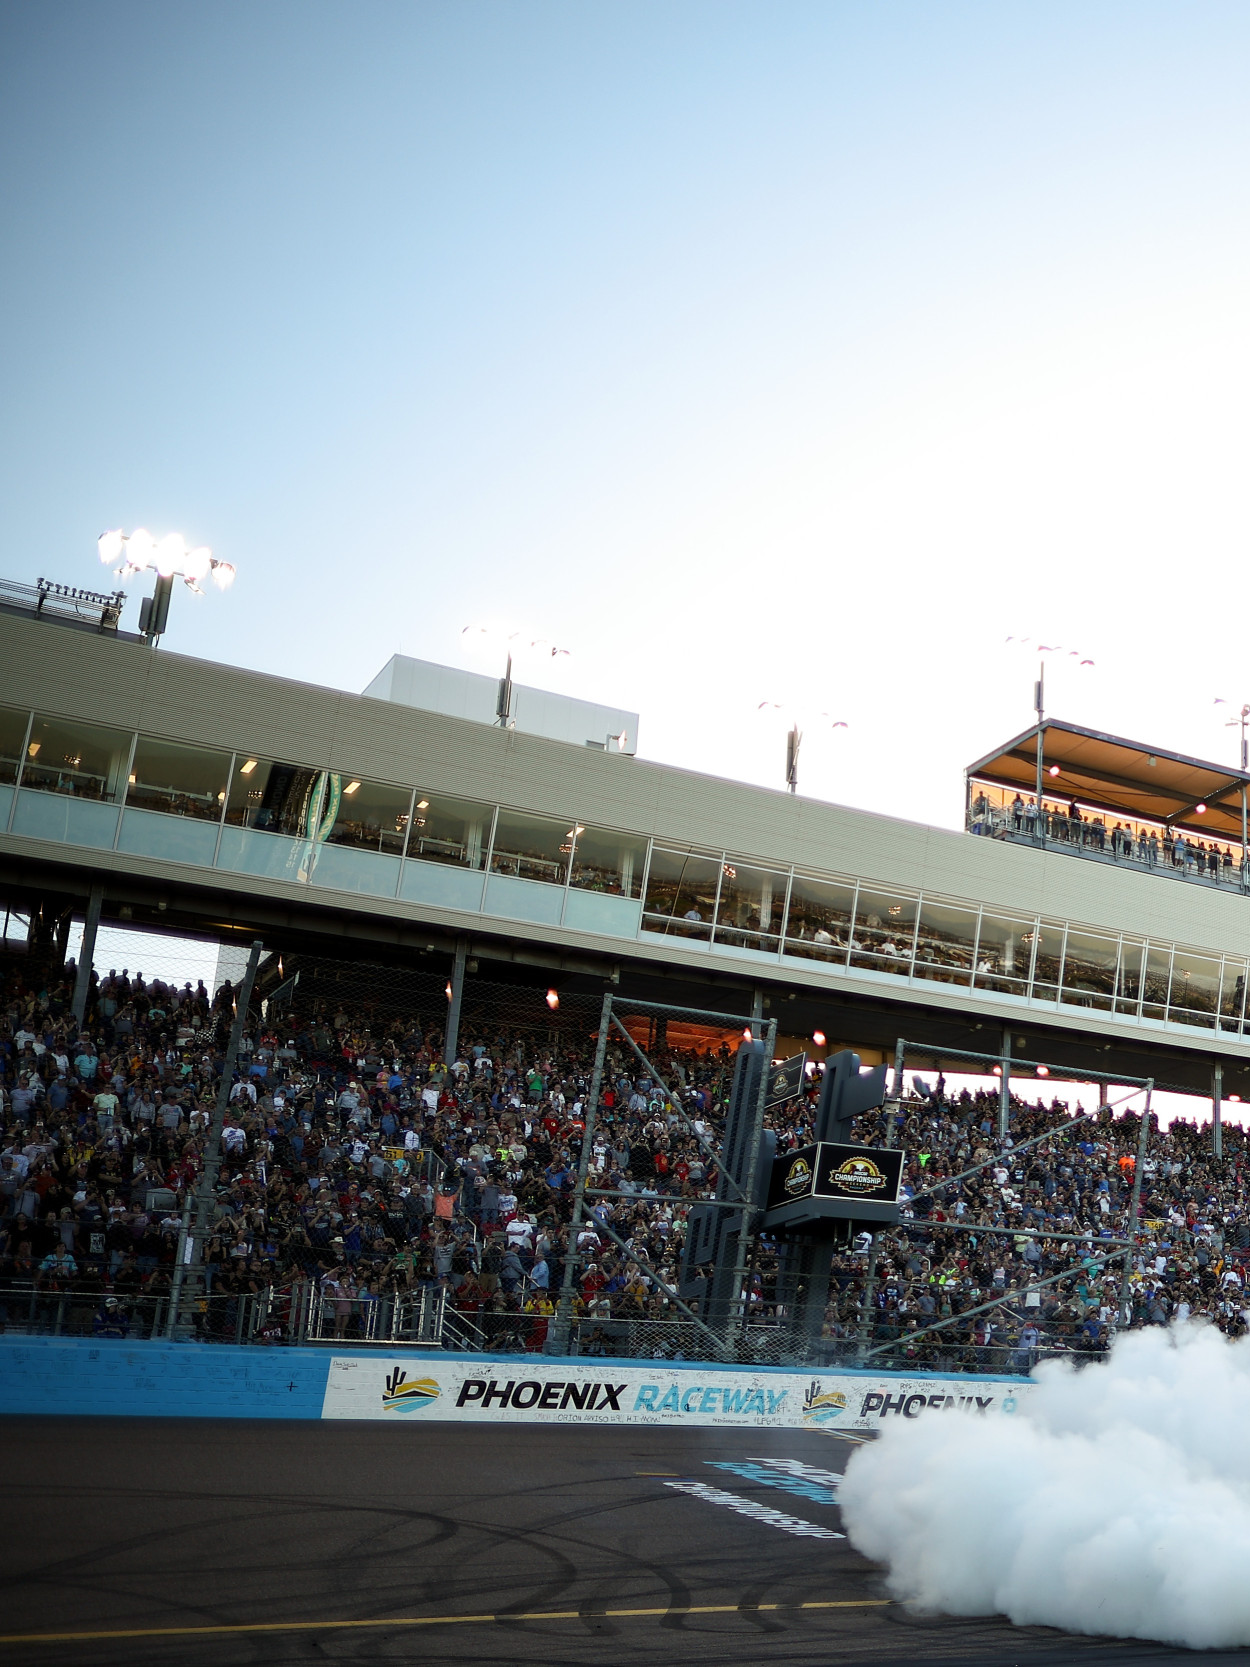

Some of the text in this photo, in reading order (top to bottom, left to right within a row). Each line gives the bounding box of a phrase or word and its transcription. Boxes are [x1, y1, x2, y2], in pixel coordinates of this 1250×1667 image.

[834, 1174, 882, 1184] CHAMPIONSHIP
[456, 1380, 790, 1415] PHOENIX RACEWAY
[860, 1393, 994, 1418] PHOENIX
[746, 1457, 845, 1486] PHOE
[663, 1482, 847, 1539] CHAMPIONSHIP
